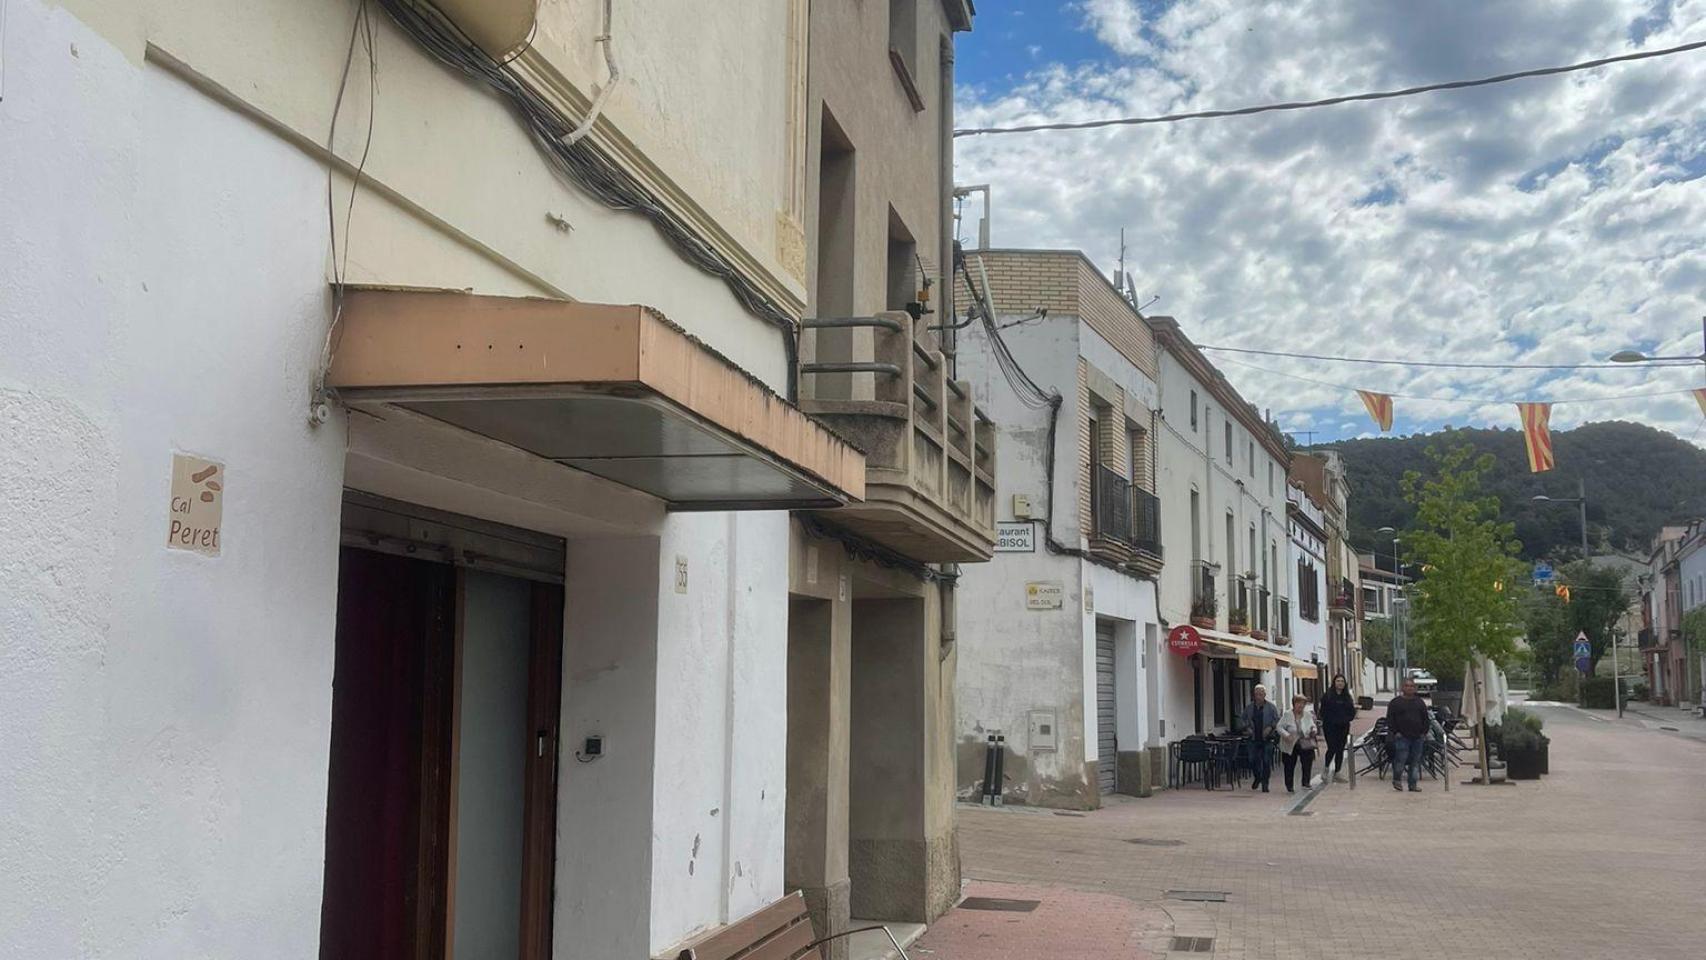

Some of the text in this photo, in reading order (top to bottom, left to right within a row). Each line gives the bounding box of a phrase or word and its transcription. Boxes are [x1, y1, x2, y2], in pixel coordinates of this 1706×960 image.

[171, 496, 192, 514] Cal
[169, 520, 219, 548] Peret
[998, 527, 1030, 536] aurant
[998, 538, 1030, 548] BISOL
